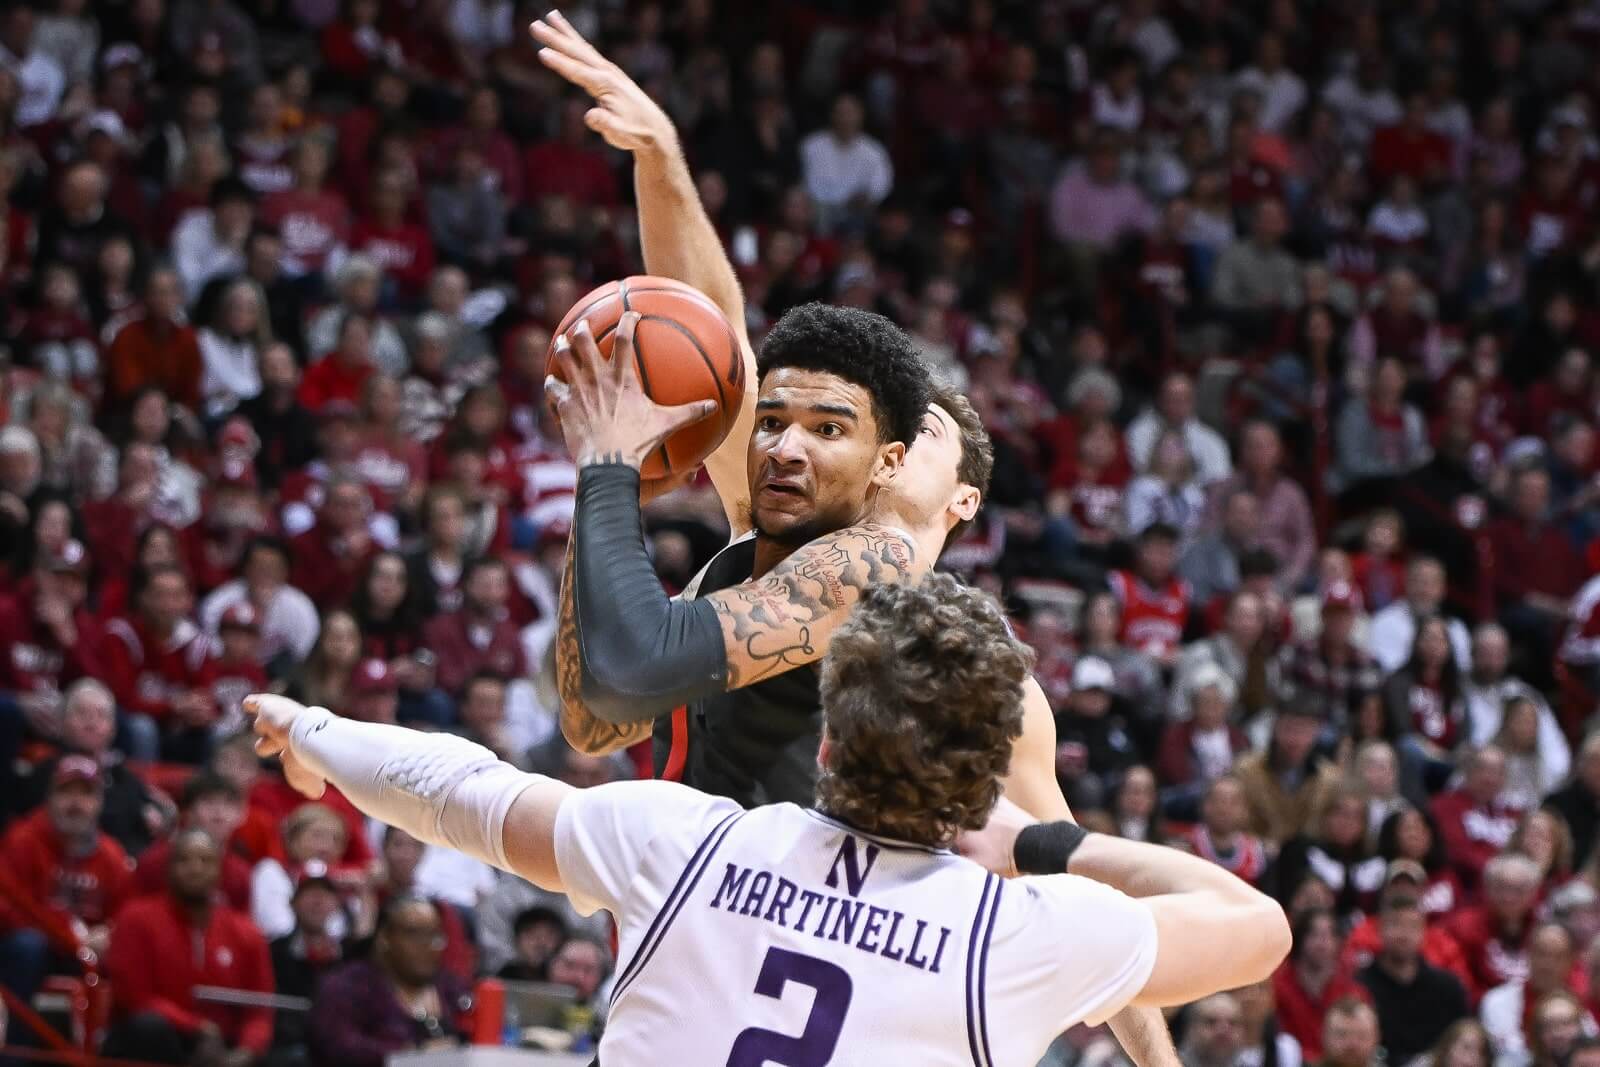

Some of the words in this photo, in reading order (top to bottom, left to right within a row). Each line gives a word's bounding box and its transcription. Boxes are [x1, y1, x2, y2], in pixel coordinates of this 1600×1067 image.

[710, 863, 952, 973] MARTINELLI
[825, 833, 880, 898] N
[725, 945, 853, 1067] 2
